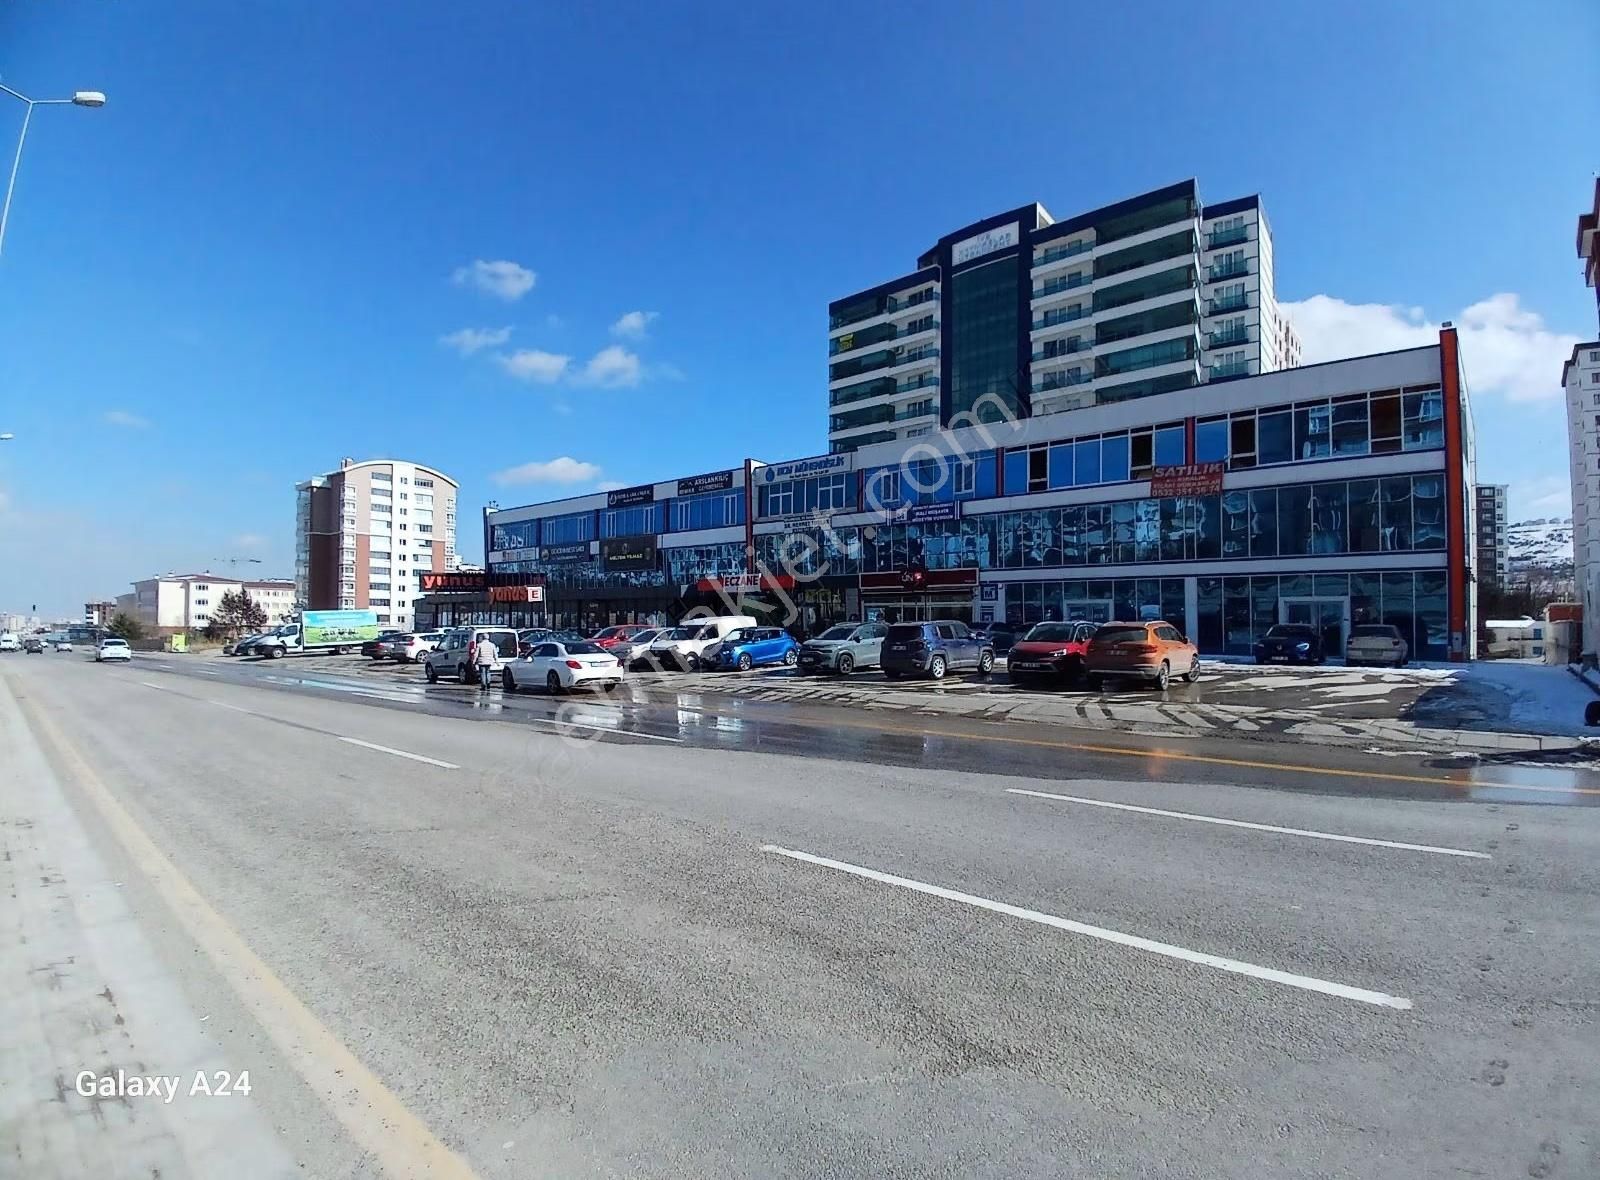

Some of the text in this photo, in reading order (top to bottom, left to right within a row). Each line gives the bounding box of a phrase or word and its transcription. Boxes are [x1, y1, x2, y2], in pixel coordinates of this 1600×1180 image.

[1154, 463, 1220, 478] SATILIK
[694, 473, 729, 487] ARSLANKILIÇ
[423, 575, 485, 589] yunus
[724, 575, 759, 587] ECZANE
[488, 585, 529, 604] yunus
